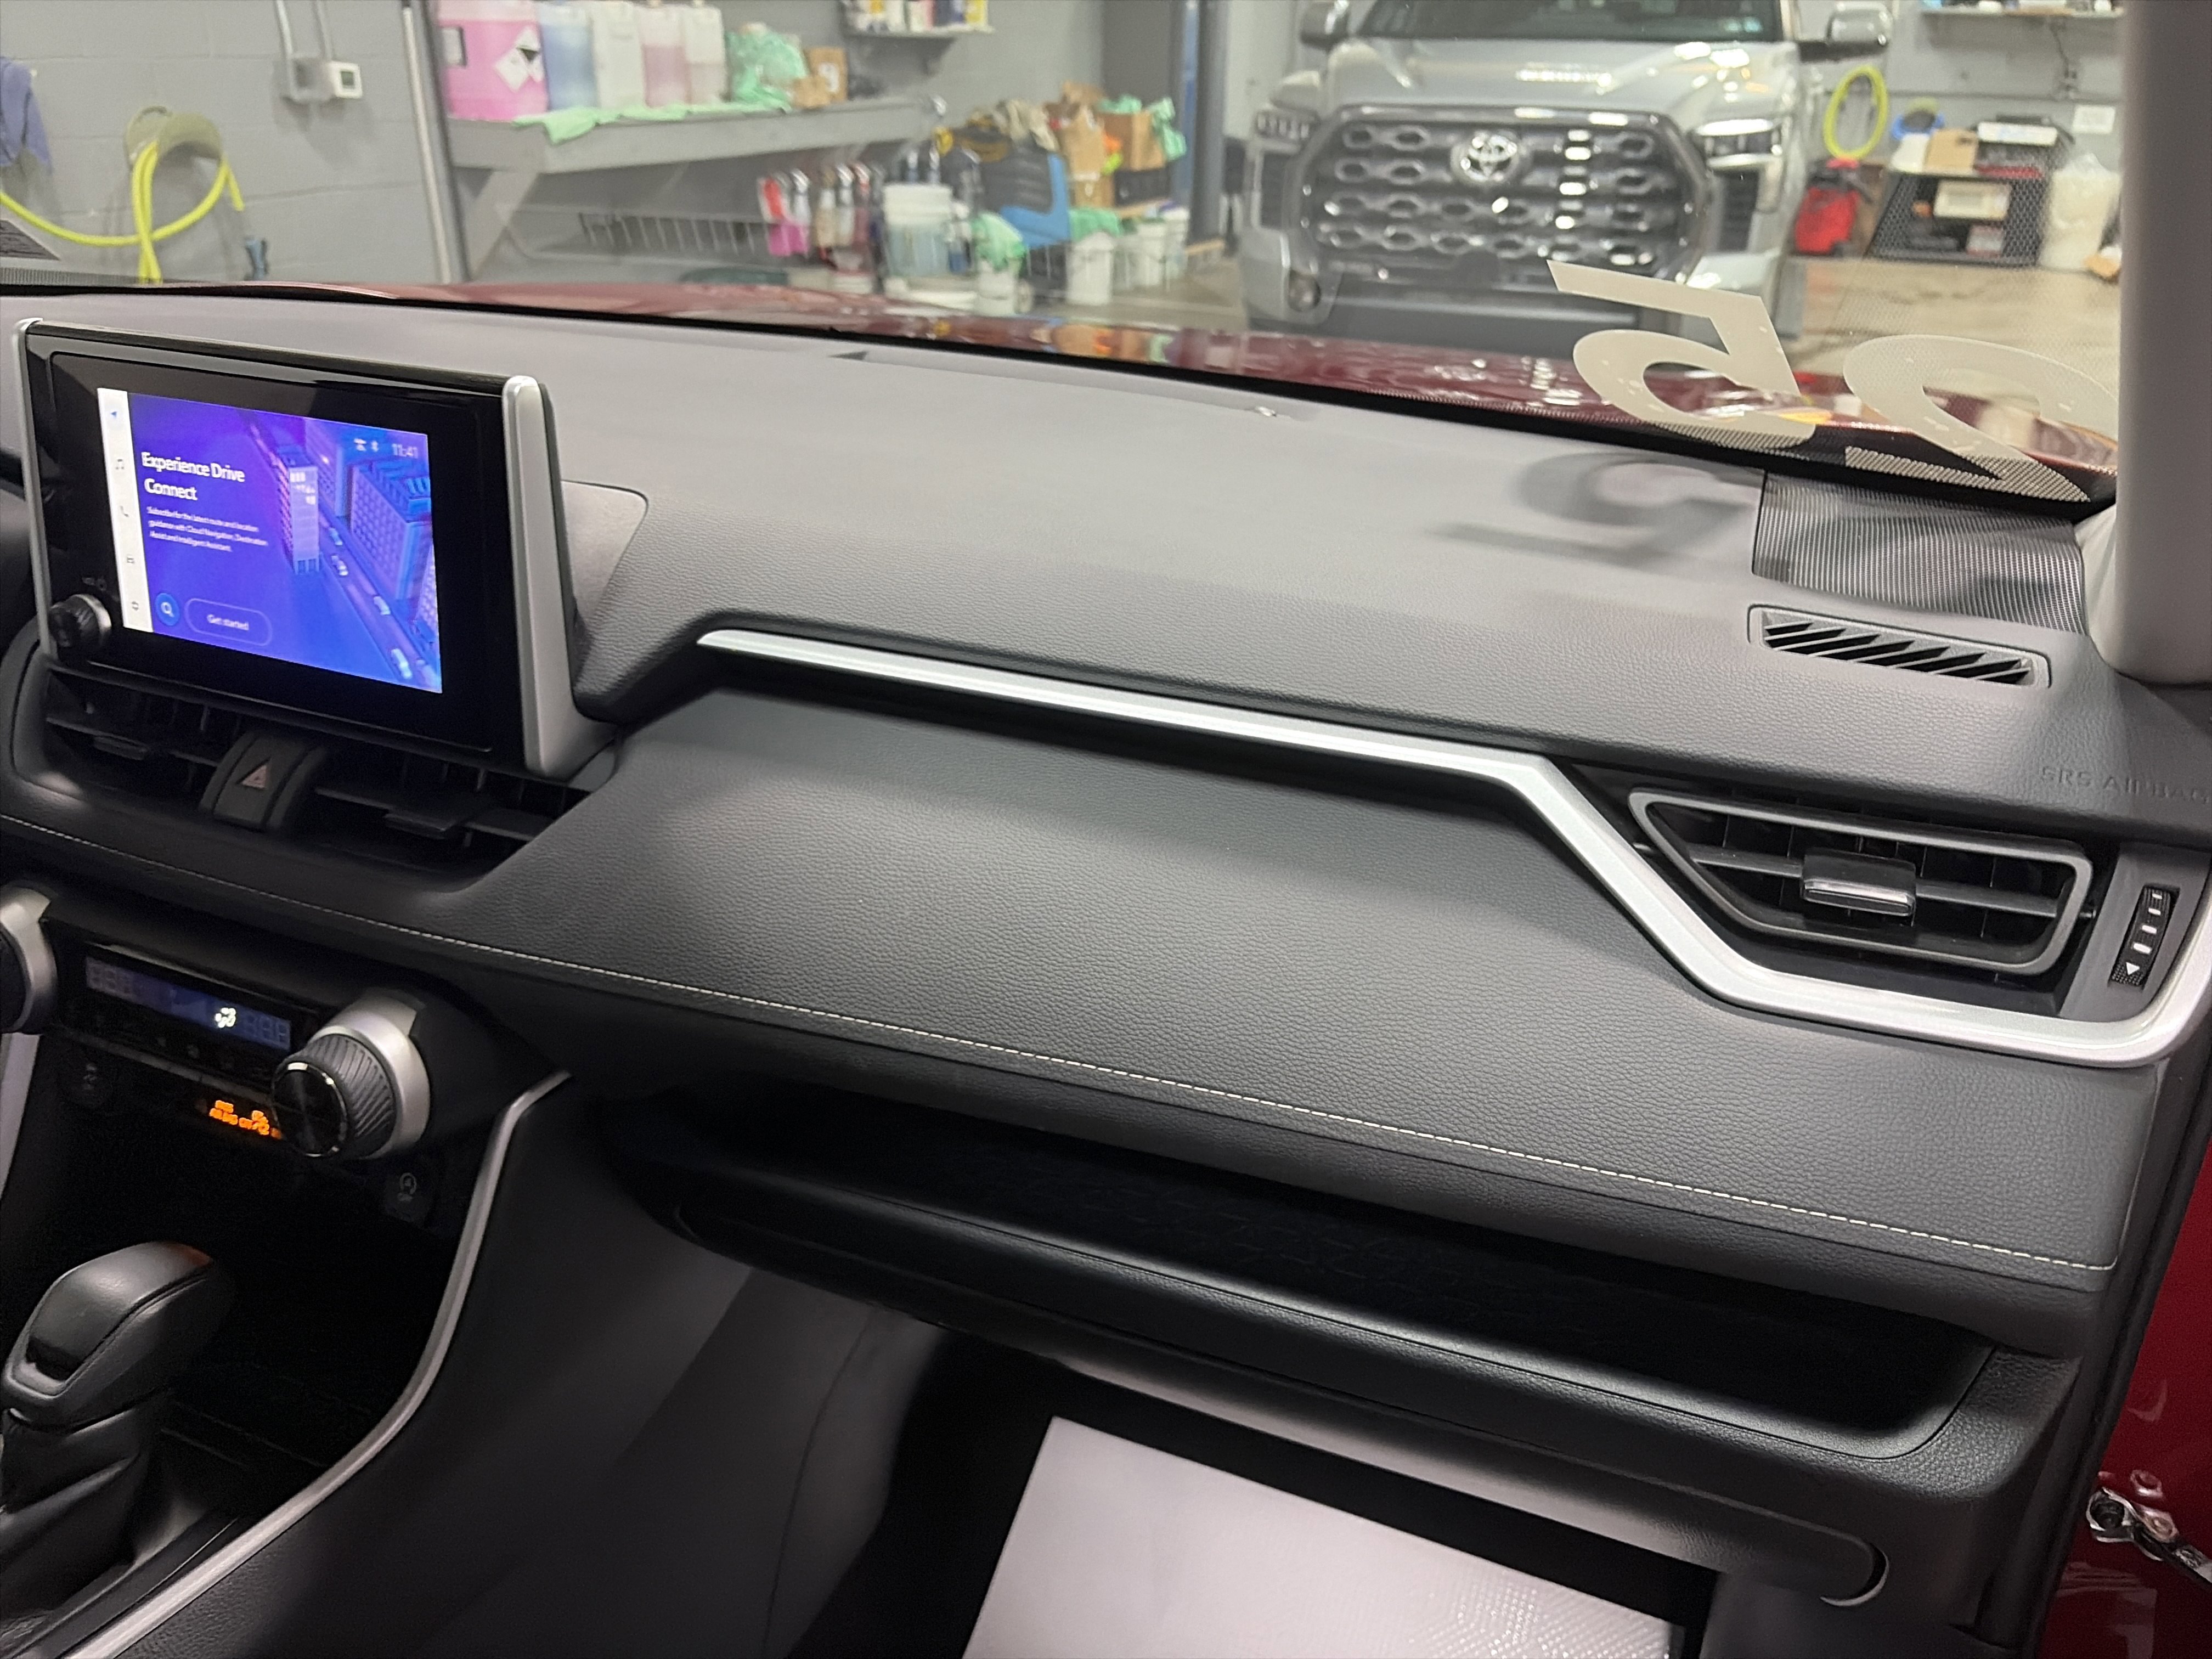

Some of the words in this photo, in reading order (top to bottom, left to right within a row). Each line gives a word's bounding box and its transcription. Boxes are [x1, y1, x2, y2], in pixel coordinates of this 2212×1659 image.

[140, 452, 210, 477] Experience
[210, 462, 245, 483] Drive
[144, 478, 198, 500] Connect
[2040, 765, 2092, 787] SRS
